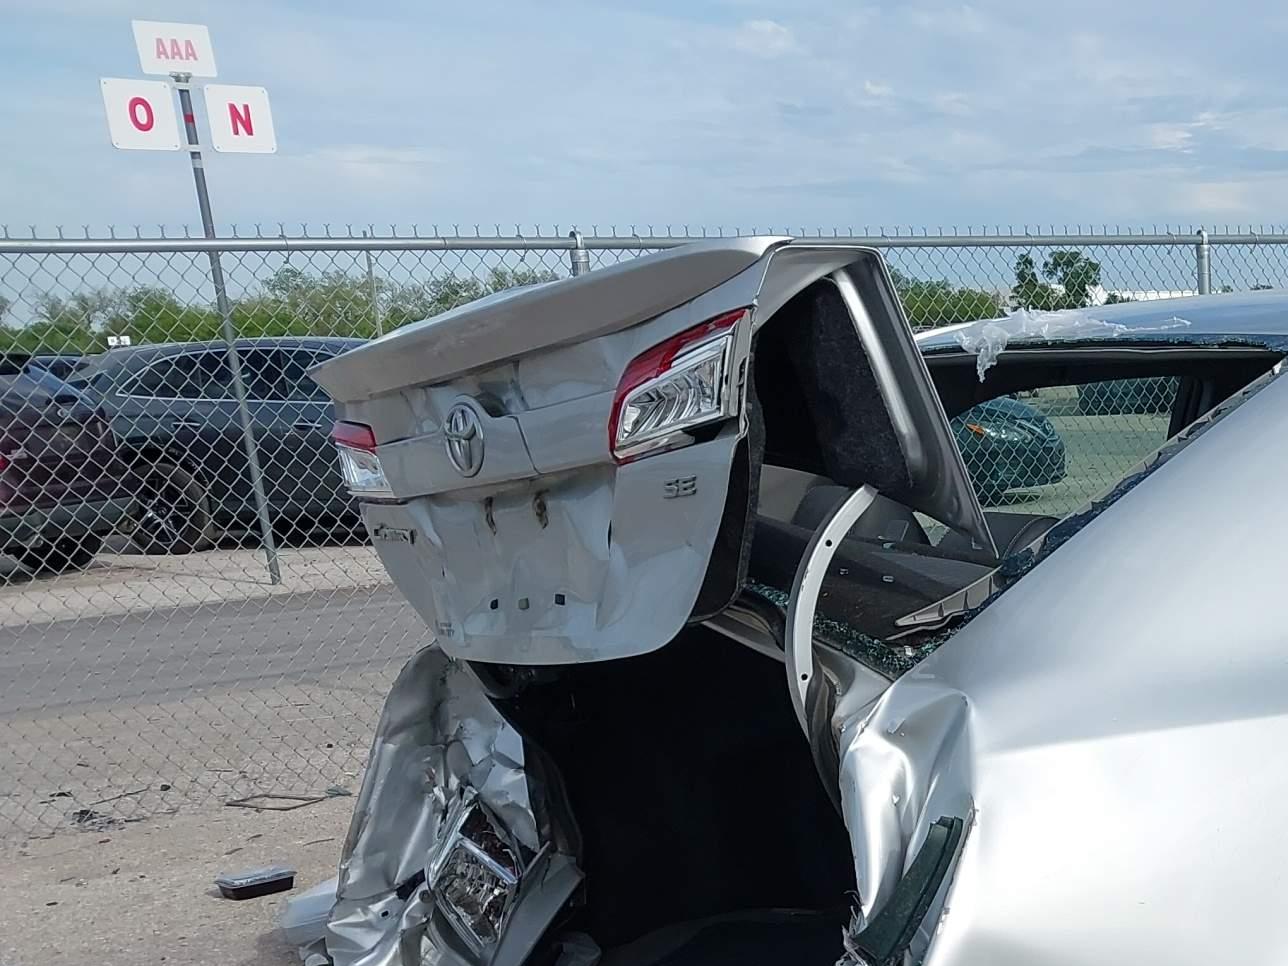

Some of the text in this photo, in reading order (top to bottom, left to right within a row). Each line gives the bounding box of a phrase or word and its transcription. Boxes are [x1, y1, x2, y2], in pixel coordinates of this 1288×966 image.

[155, 37, 198, 61] AAA
[128, 96, 154, 132] O
[227, 102, 254, 136] N
